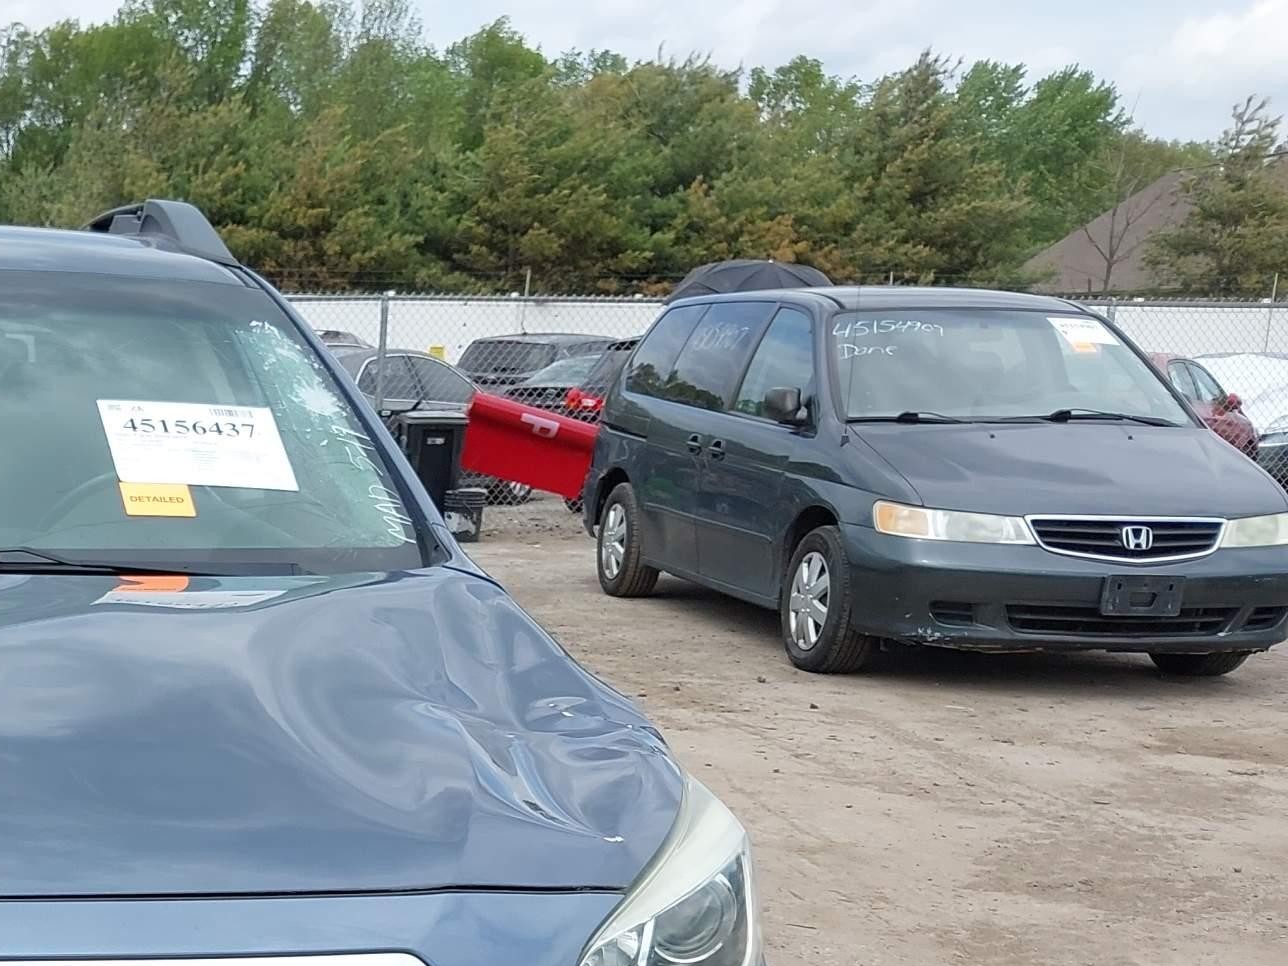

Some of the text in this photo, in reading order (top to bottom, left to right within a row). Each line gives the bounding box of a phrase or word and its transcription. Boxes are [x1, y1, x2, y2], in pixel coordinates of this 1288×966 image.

[123, 417, 255, 438] 45156437
[129, 495, 185, 505] DETAILED
[368, 485, 417, 544] MAD
